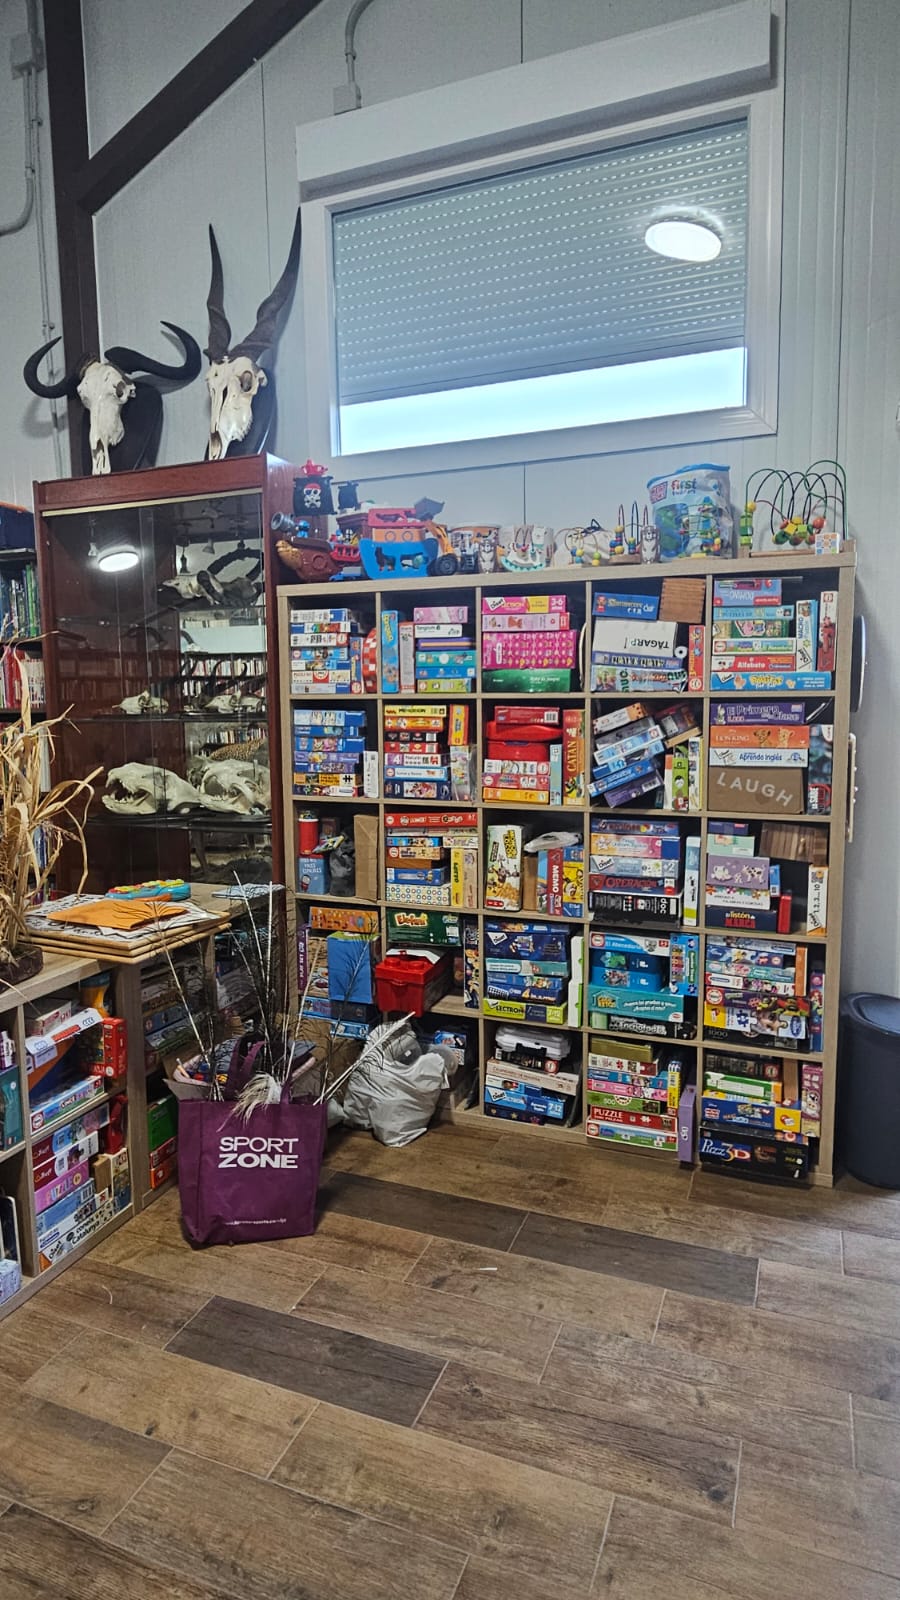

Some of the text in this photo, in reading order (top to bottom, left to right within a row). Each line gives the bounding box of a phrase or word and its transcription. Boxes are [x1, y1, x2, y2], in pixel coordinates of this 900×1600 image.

[671, 478, 697, 490] first
[567, 740, 577, 772] CATAN
[716, 772, 793, 807] LAUGH
[593, 1108, 623, 1118] PUZZLE
[219, 1136, 299, 1153] SPORT
[218, 1153, 299, 1169] ZONE
